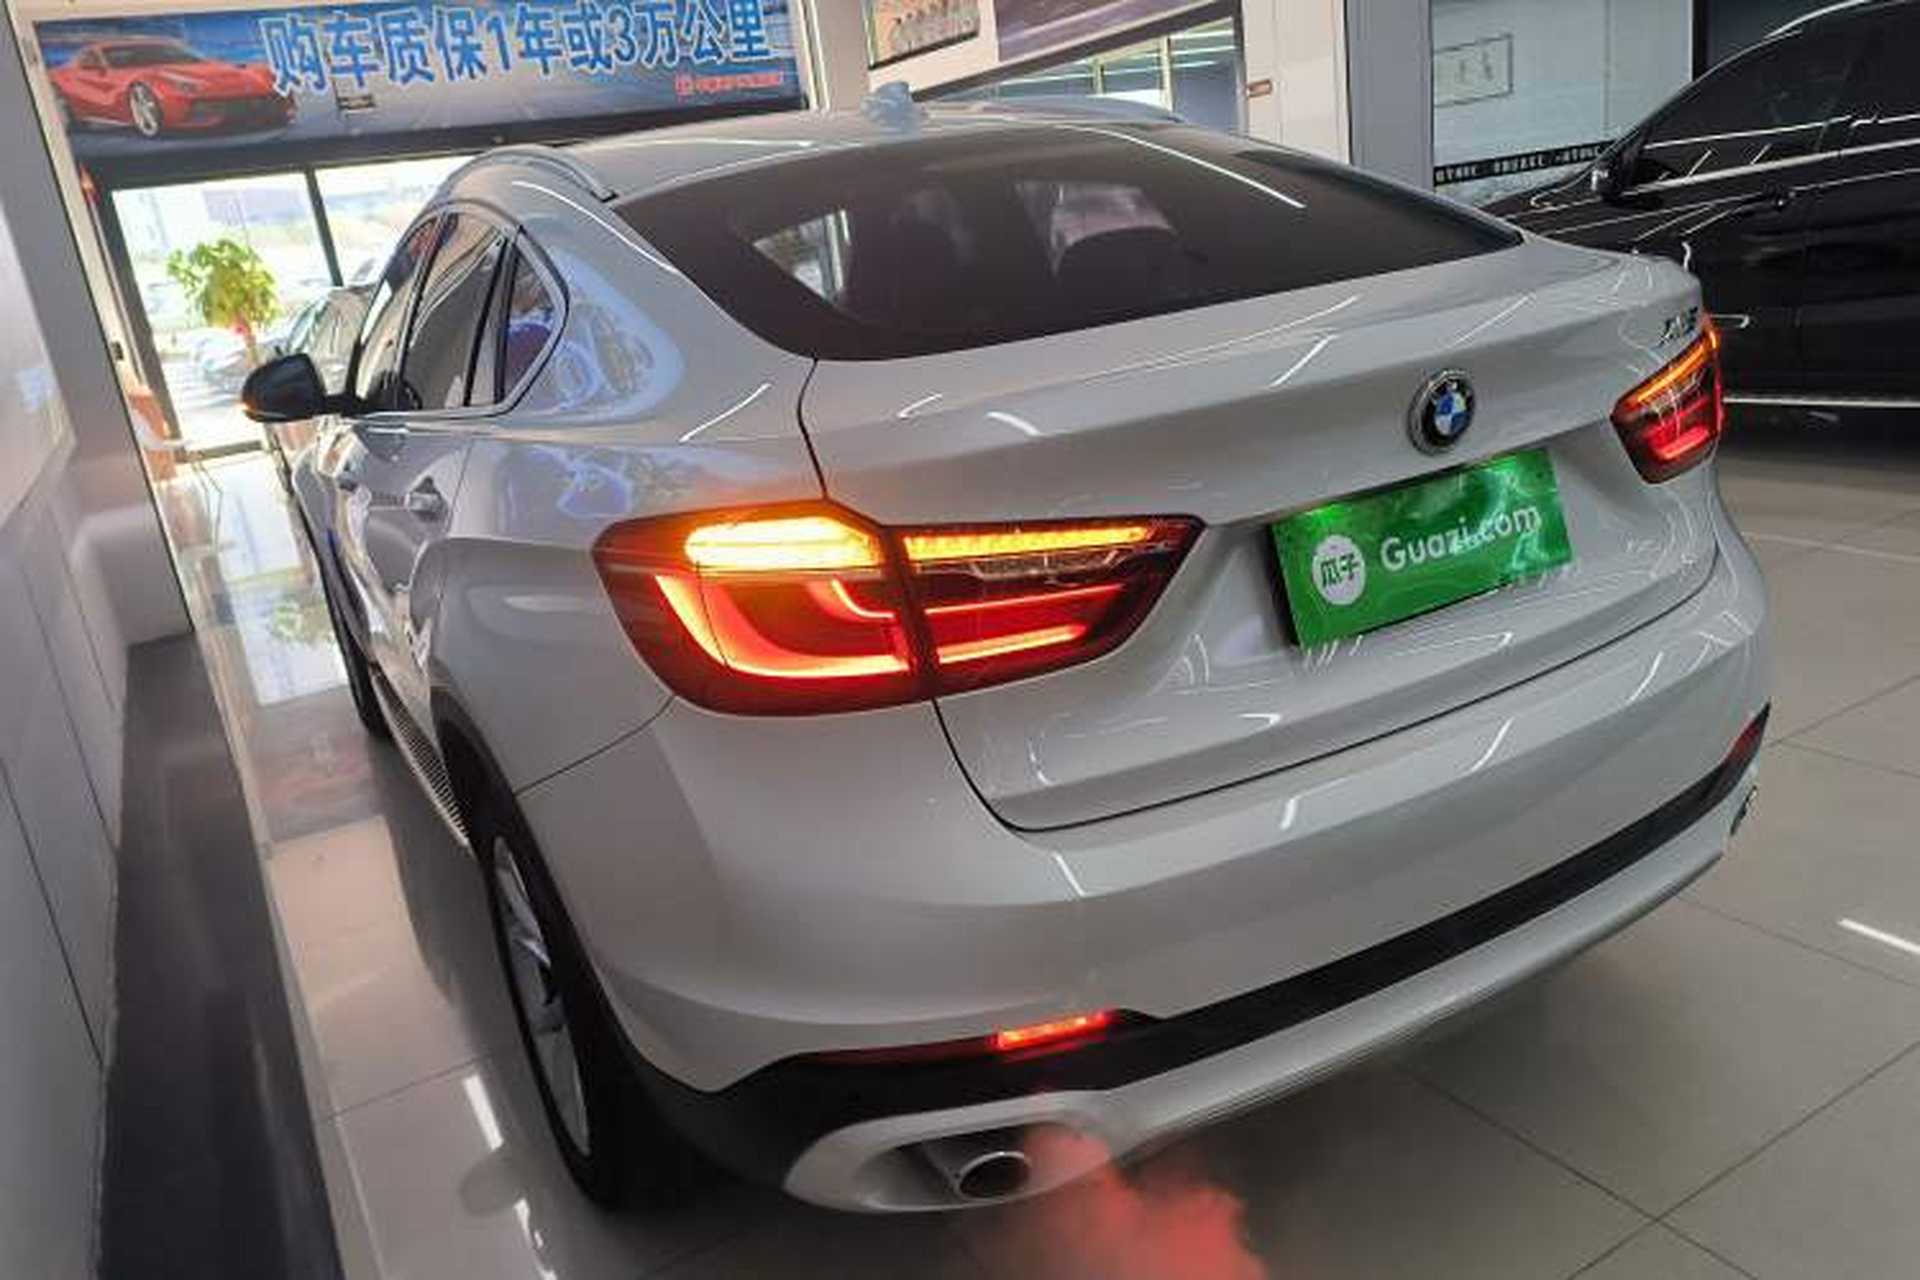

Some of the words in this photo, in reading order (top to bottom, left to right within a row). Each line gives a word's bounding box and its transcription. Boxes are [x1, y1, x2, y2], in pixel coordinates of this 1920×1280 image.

[261, 0, 771, 95] 购车质保1年或3万公里
[1382, 506, 1542, 571] Guazi.com
